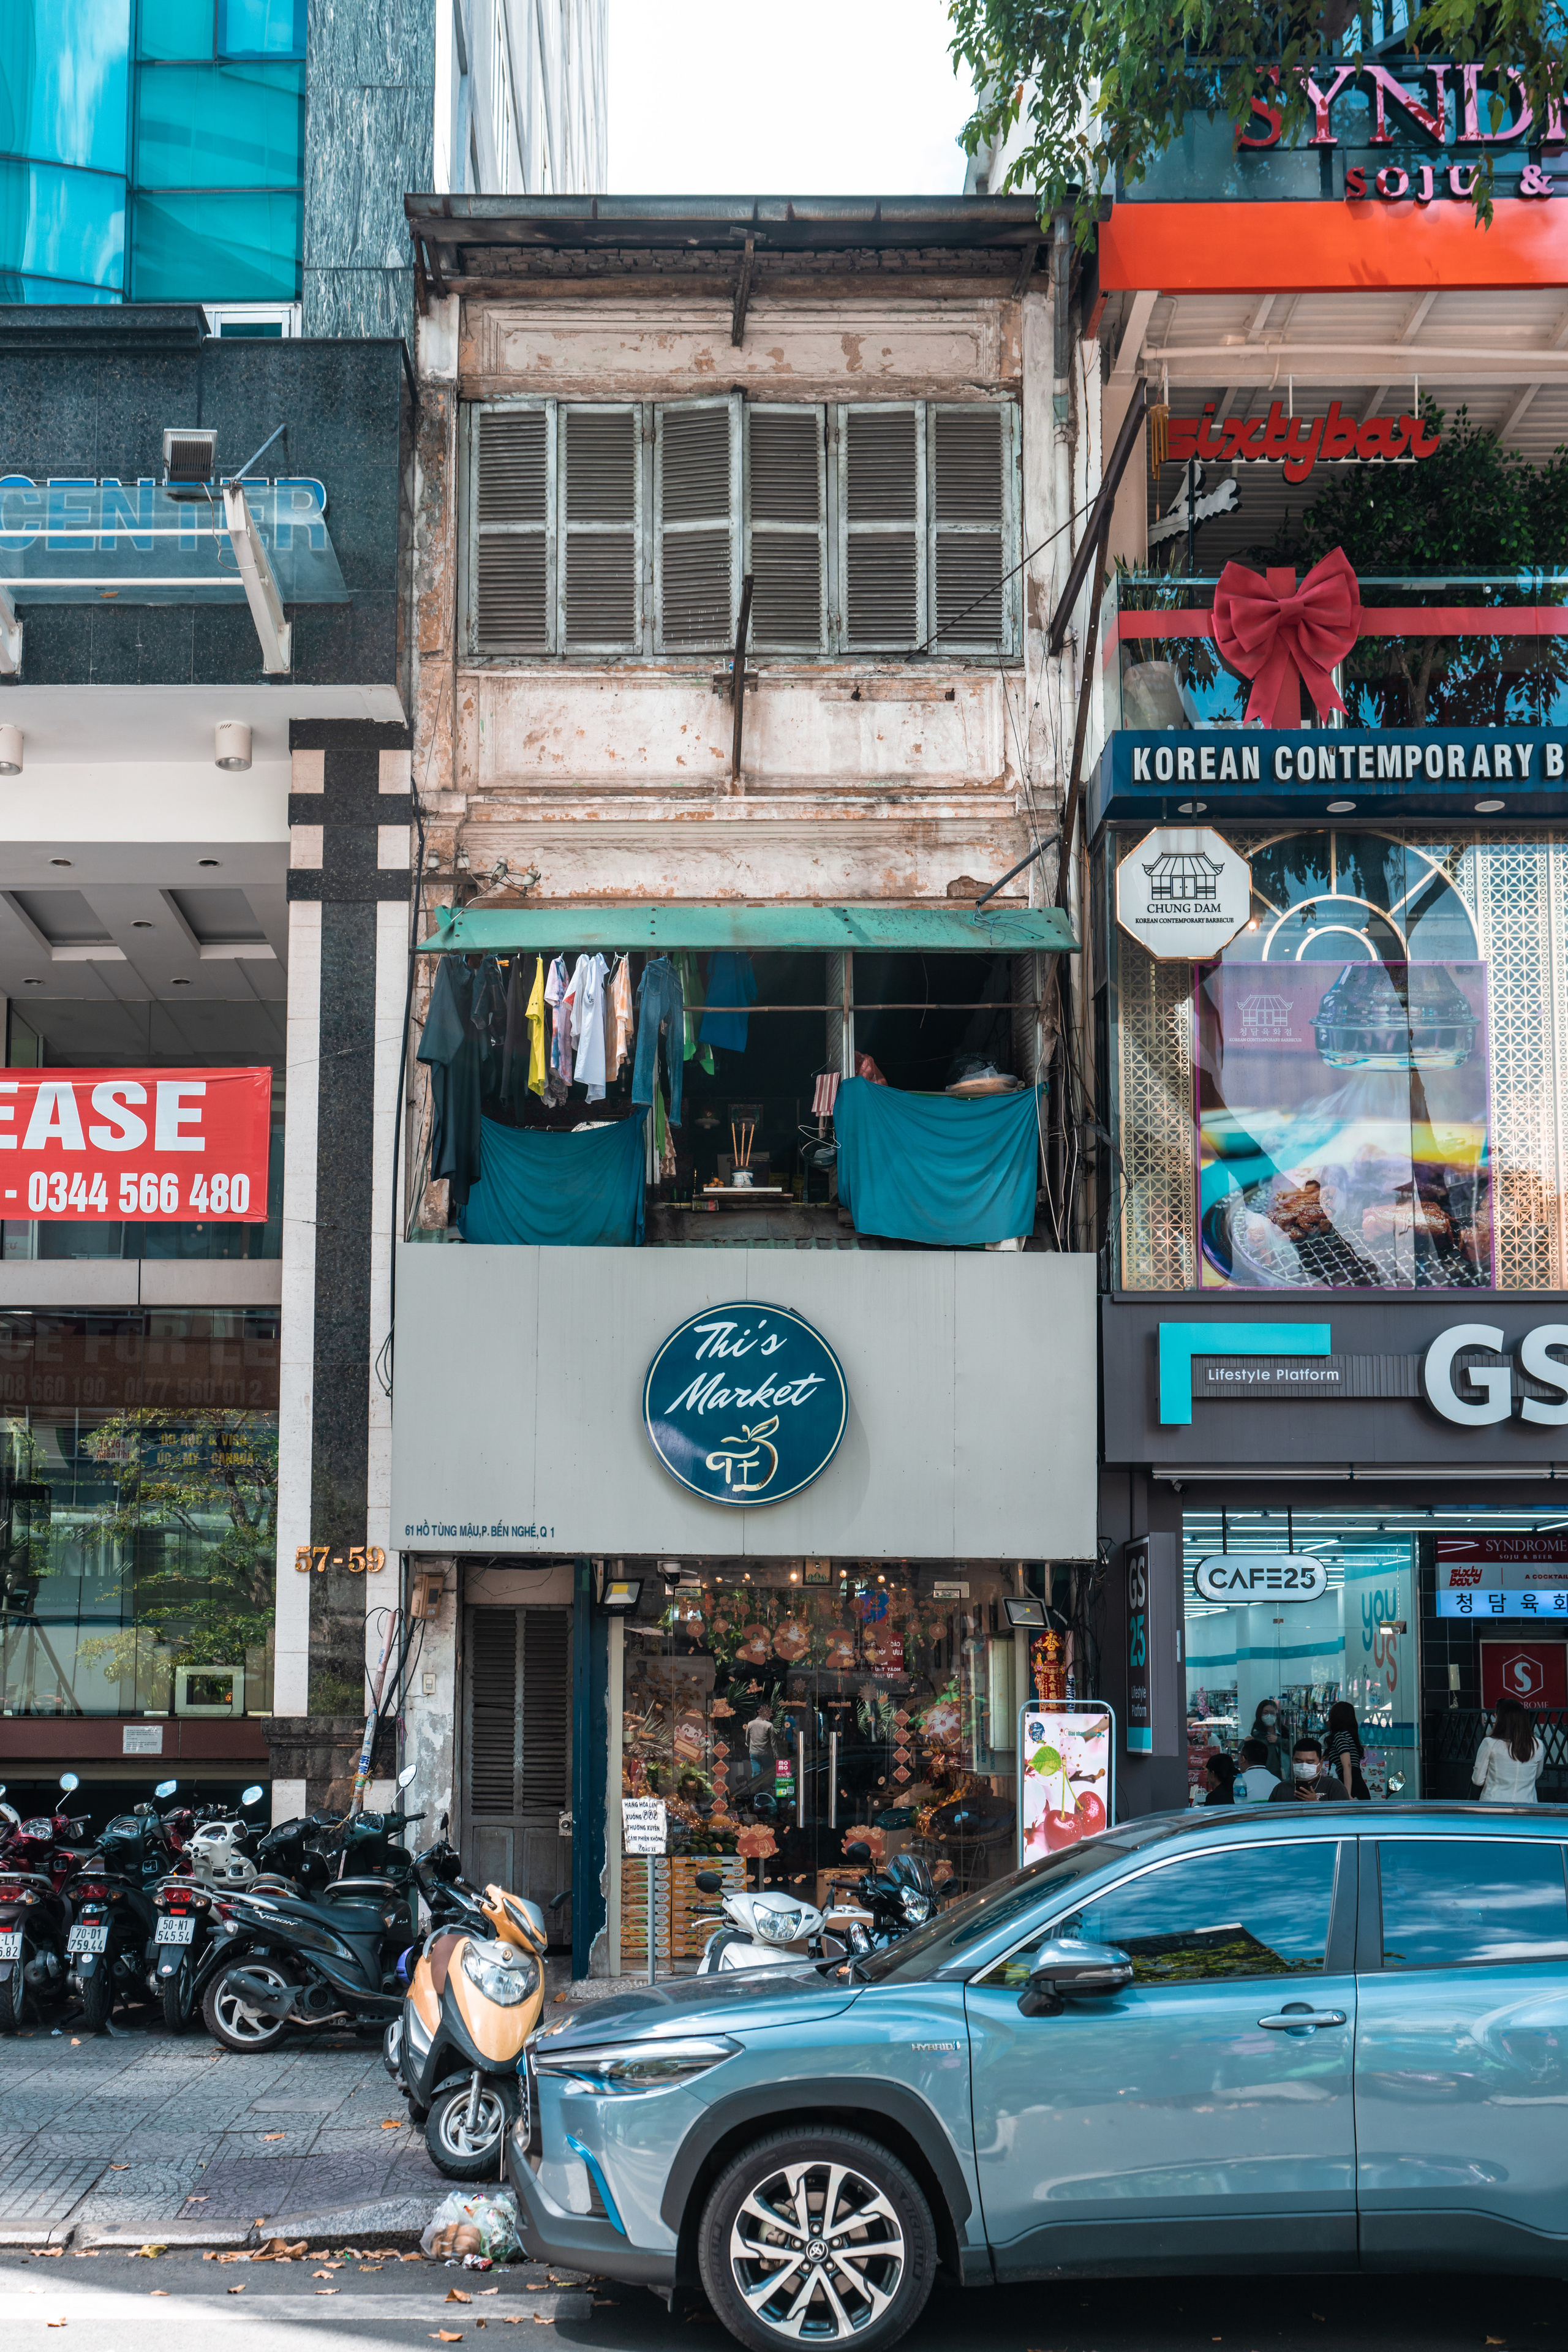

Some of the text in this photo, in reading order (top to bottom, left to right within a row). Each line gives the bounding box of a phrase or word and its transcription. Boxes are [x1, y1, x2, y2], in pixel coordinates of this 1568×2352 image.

[1519, 164, 1555, 196] &
[1169, 401, 1441, 483] sixtybar
[1133, 746, 1260, 783] KOREAN
[1275, 743, 1534, 781] CONTEMPORARY
[1147, 903, 1221, 913] CHUNG DAM
[28, 1171, 108, 1212] 0344
[119, 1172, 179, 1213] 566
[189, 1173, 250, 1213] 480
[694, 1320, 787, 1360] Thi's
[1208, 1368, 1340, 1384] Lifestyle Platform
[1425, 1324, 1568, 1425] GS
[664, 1372, 826, 1415] Market
[405, 1525, 414, 1536] 61
[416, 1519, 430, 1536] HỒ
[432, 1522, 457, 1536] TÙNG
[491, 1520, 509, 1537] BẾN
[1485, 1539, 1567, 1552] SYNDROME
[295, 1546, 386, 1573] 57-59
[1129, 1556, 1145, 1610] GS
[1208, 1567, 1316, 1589] CAFE25
[1449, 1574, 1473, 1586] bar
[1450, 1566, 1483, 1584] sixty
[1129, 1615, 1146, 1667] 25
[70, 1939, 103, 1951] 759.44
[157, 1931, 190, 1942] 545.54
[911, 2042, 956, 2052] HYBRID
